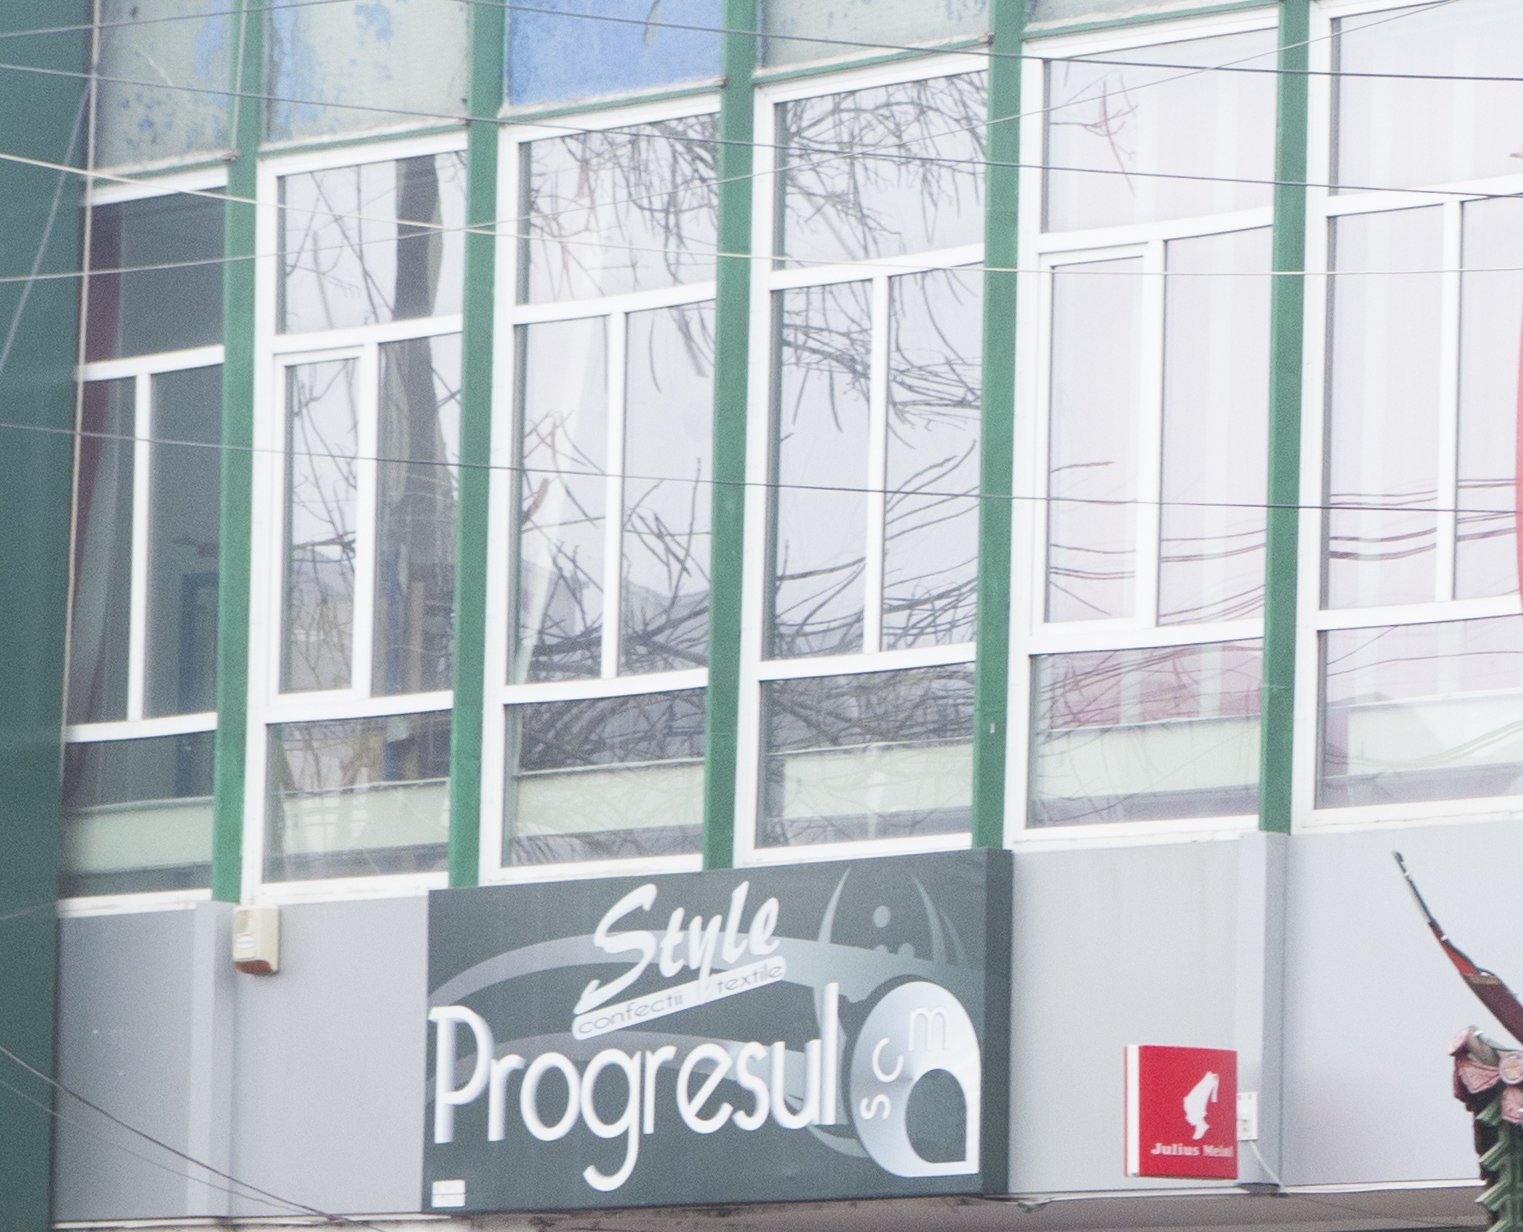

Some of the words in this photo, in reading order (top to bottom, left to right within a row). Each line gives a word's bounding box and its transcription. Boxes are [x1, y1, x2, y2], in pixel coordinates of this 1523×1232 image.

[574, 881, 780, 1015] Style
[578, 990, 684, 1034] confectii
[716, 963, 783, 993] textile
[428, 982, 840, 1192] Progresul
[1151, 1143, 1200, 1156] Julius
